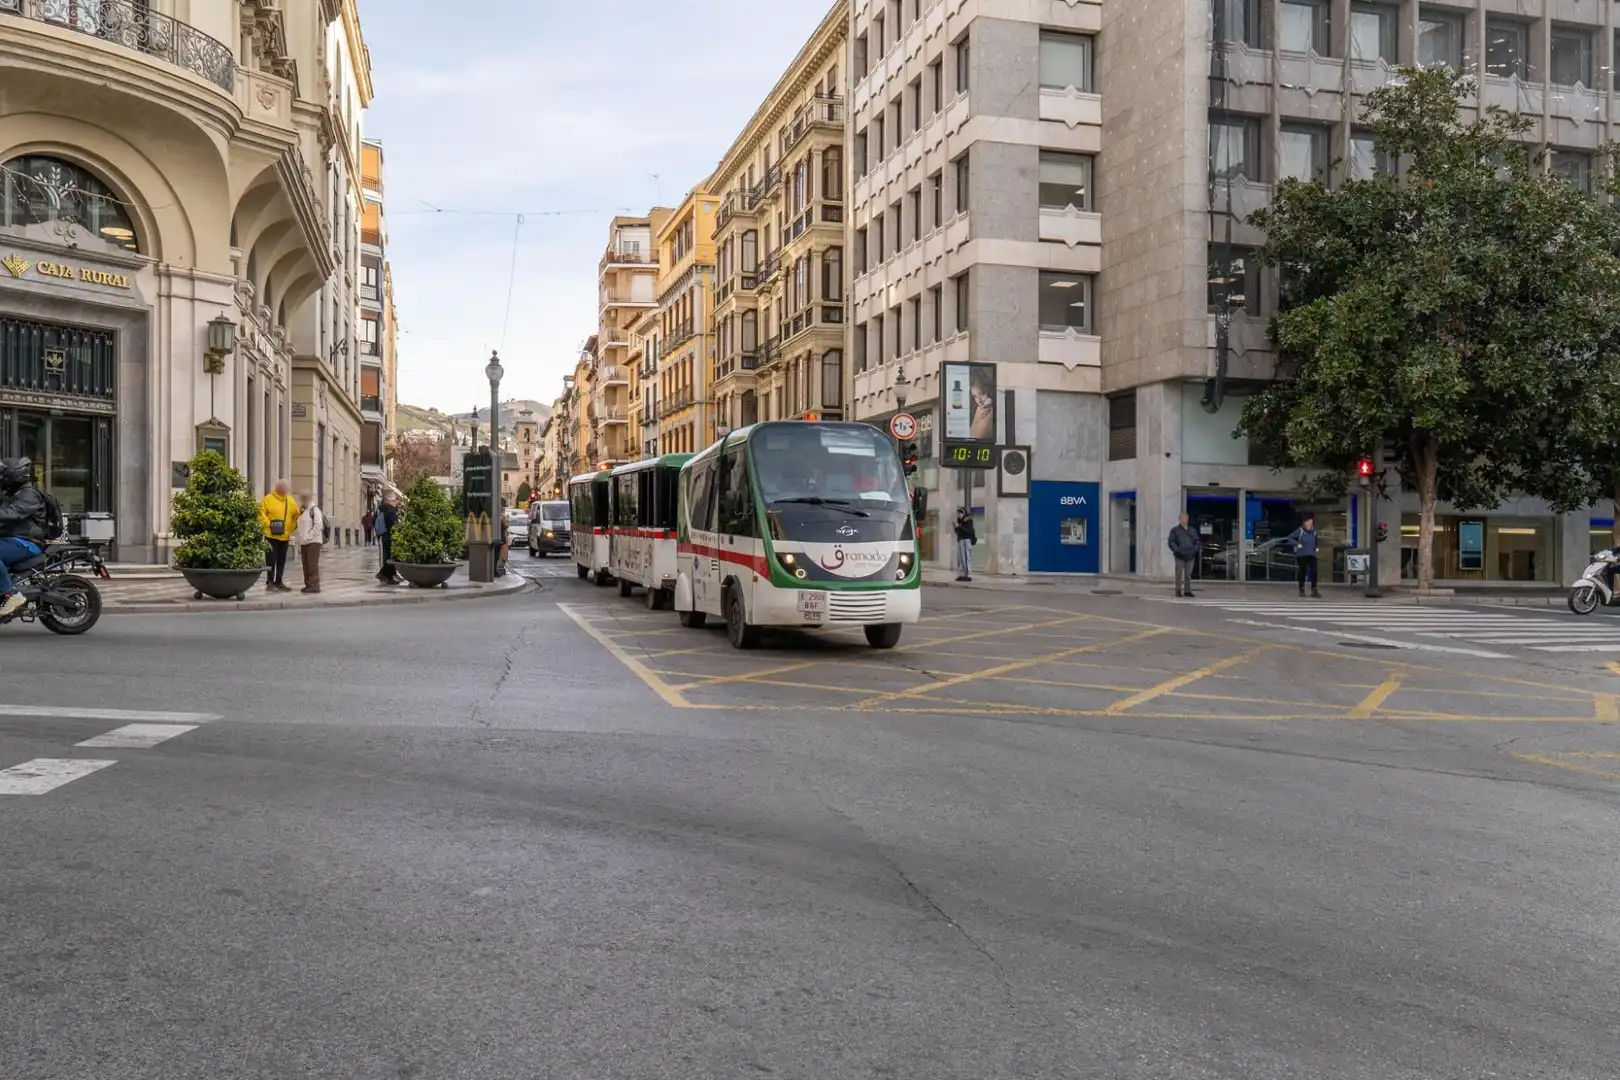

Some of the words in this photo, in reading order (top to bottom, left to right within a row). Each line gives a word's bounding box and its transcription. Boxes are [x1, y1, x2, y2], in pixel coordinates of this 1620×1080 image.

[36, 261, 75, 279] CAJA
[80, 268, 131, 289] RURAL
[1060, 496, 1087, 505] BBVA
